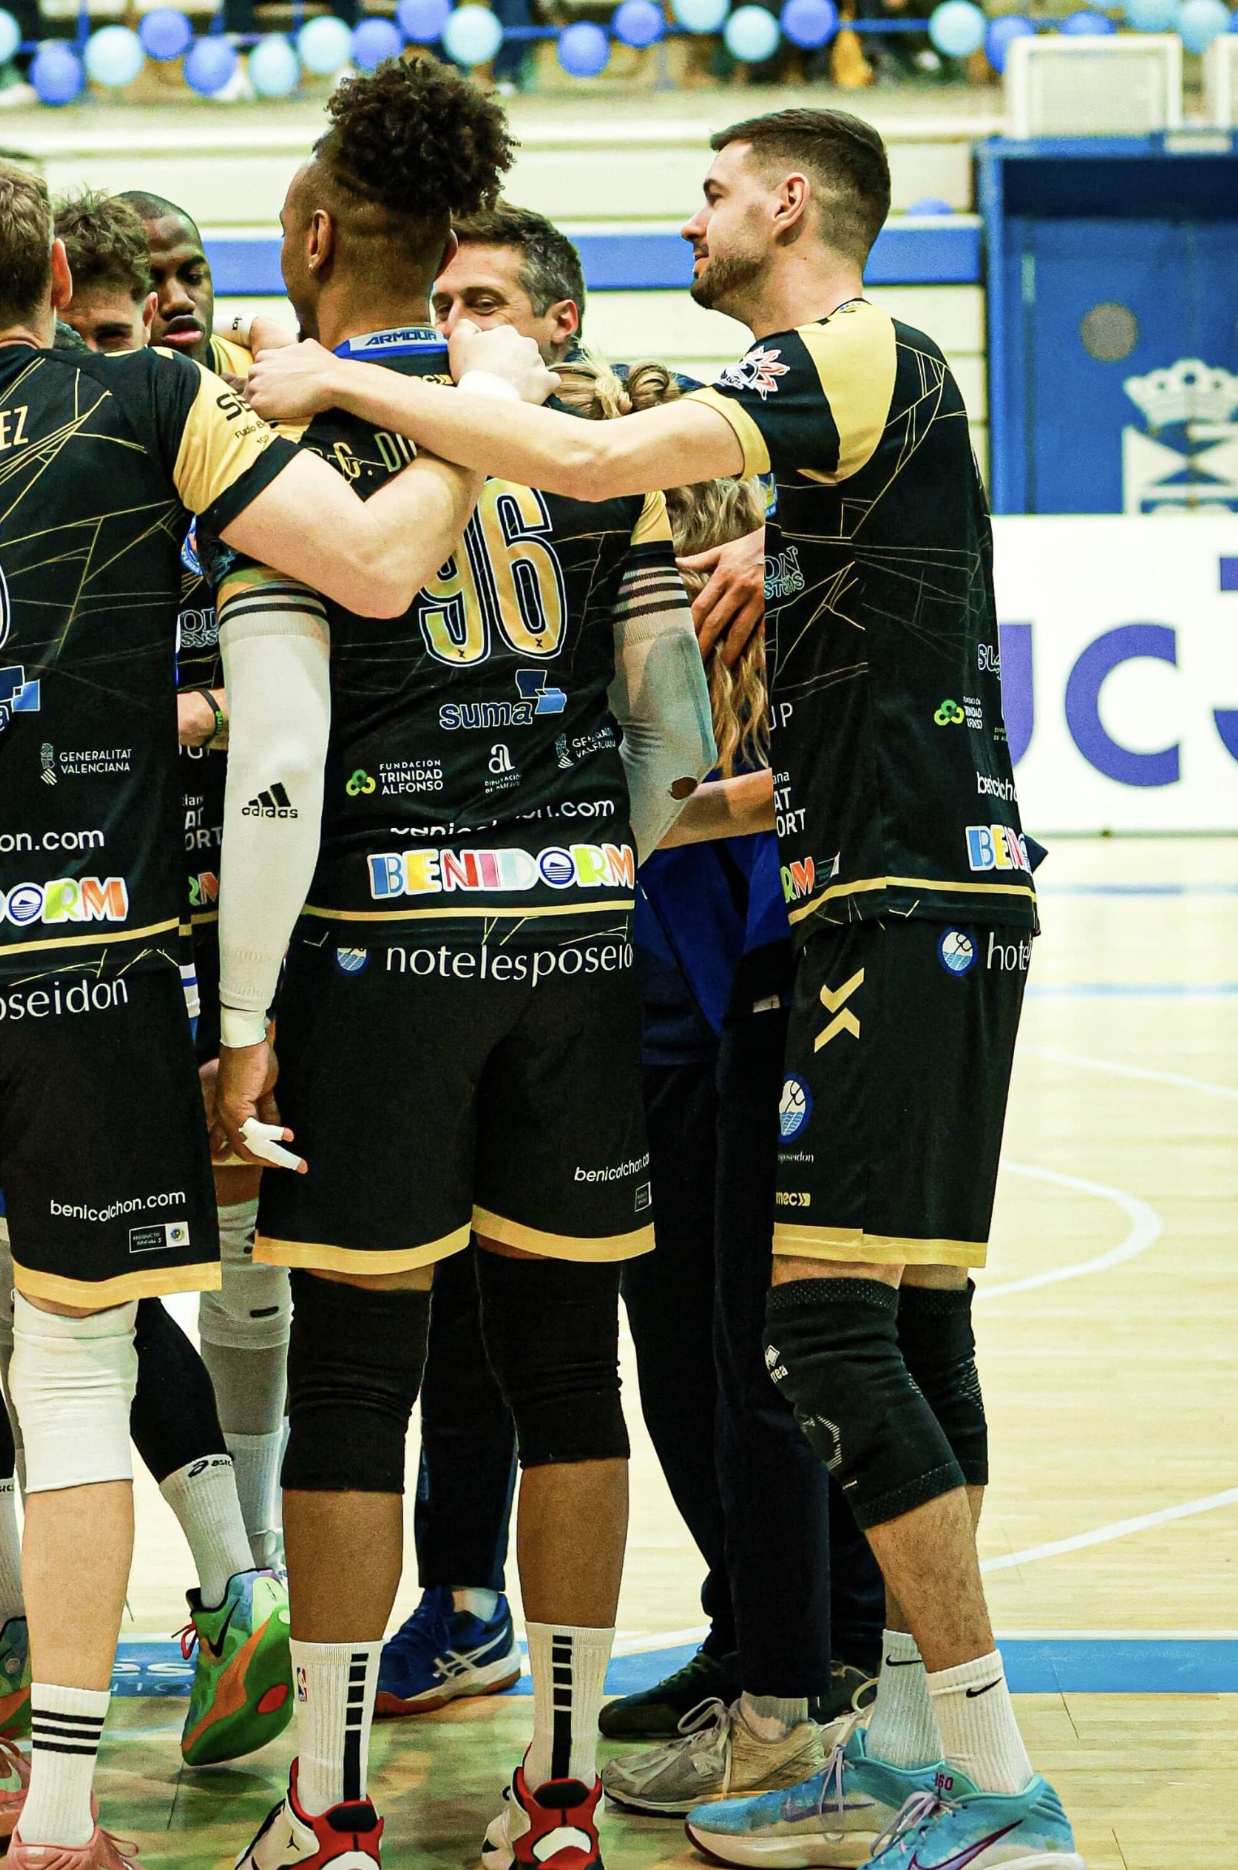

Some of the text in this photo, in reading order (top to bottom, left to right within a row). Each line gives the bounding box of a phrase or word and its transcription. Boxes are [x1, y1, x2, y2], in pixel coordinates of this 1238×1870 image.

[365, 330, 438, 347] ARMOUR
[418, 476, 569, 668] 96
[438, 701, 534, 731] suma
[58, 748, 133, 763] GENERALITAT
[60, 761, 131, 775] VALENCIANA
[379, 768, 444, 784] TRINIDAD
[380, 780, 445, 796] ALFONSO
[241, 802, 299, 819] adidas
[366, 842, 636, 900] BENIDORM
[49, 1190, 187, 1223] benicolchon.com
